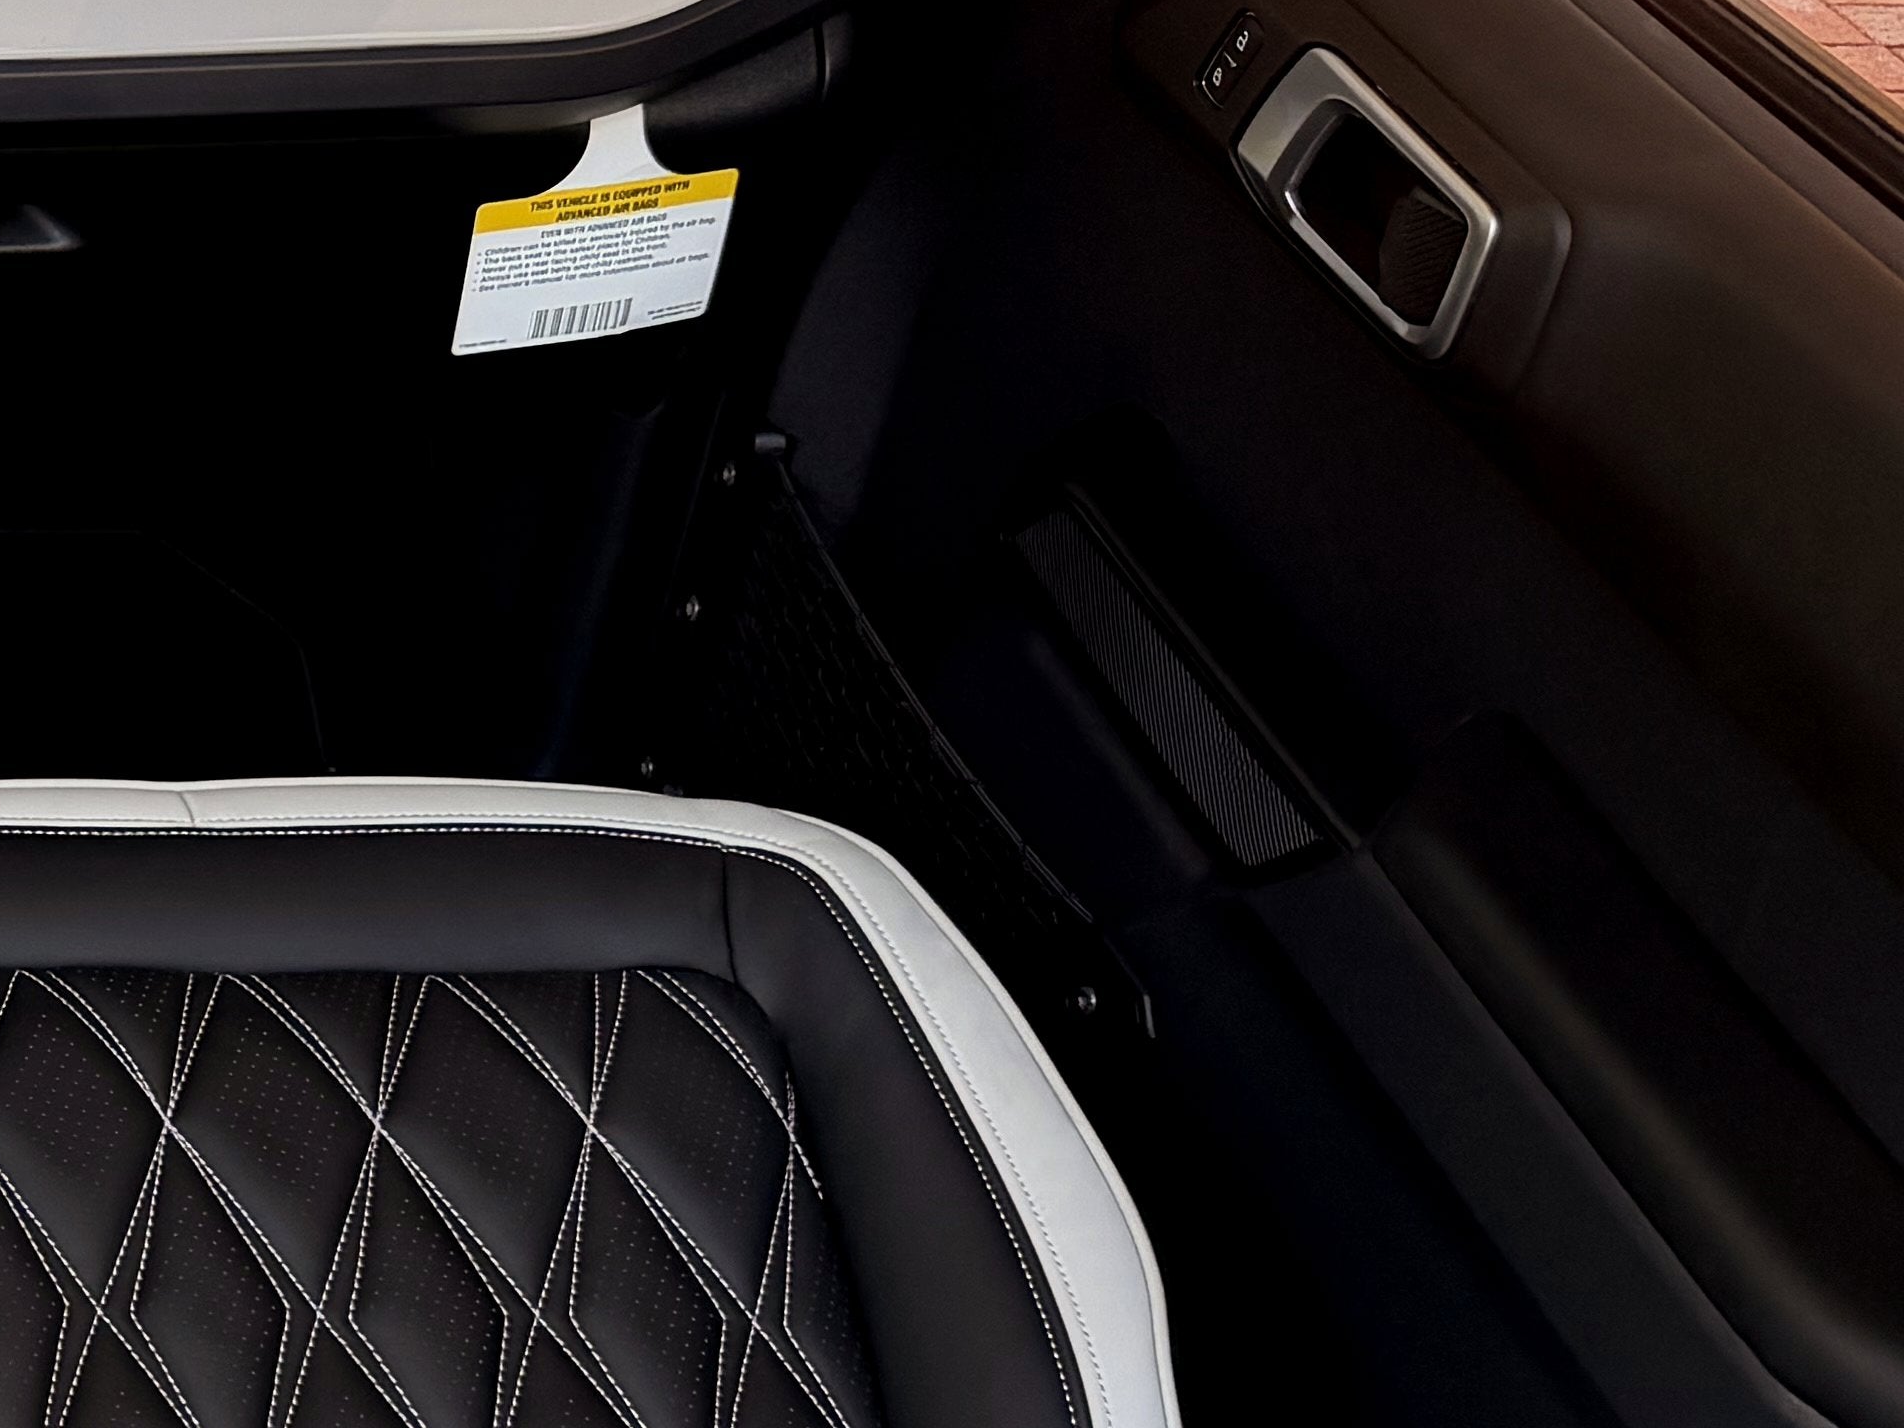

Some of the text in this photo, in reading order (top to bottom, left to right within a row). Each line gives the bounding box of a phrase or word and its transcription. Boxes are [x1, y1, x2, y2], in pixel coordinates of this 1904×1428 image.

[531, 180, 690, 212] THIS VEHICLE IS EQUIPPED WITH
[555, 198, 659, 222] ADVANCED AIR BAGS
